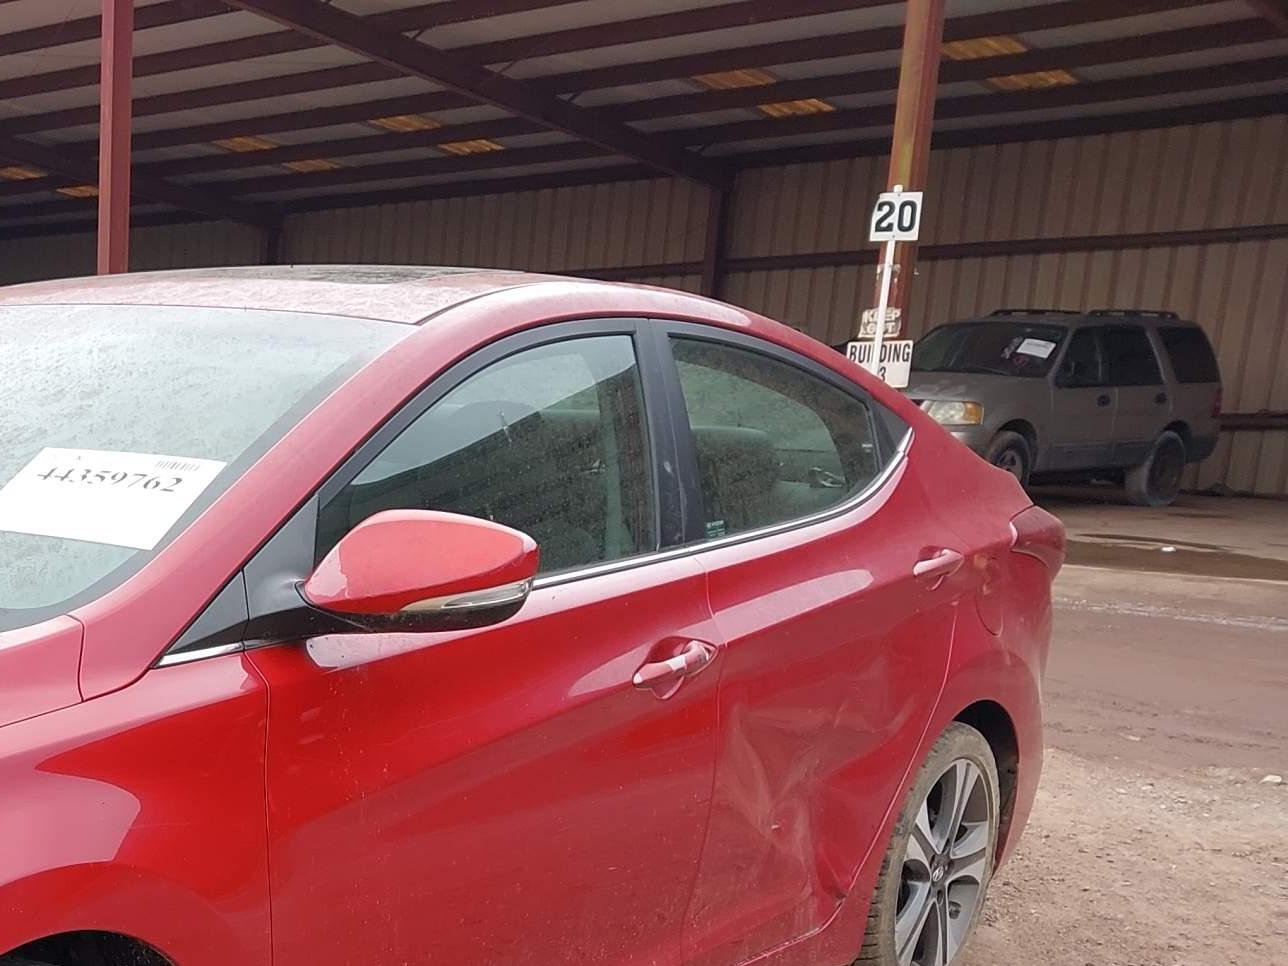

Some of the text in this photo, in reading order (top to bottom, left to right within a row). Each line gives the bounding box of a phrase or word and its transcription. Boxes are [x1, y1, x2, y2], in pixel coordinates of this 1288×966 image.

[875, 200, 917, 232] 20
[867, 322, 896, 334] OT
[850, 343, 911, 363] BUIDING
[37, 467, 183, 492] 44359762
